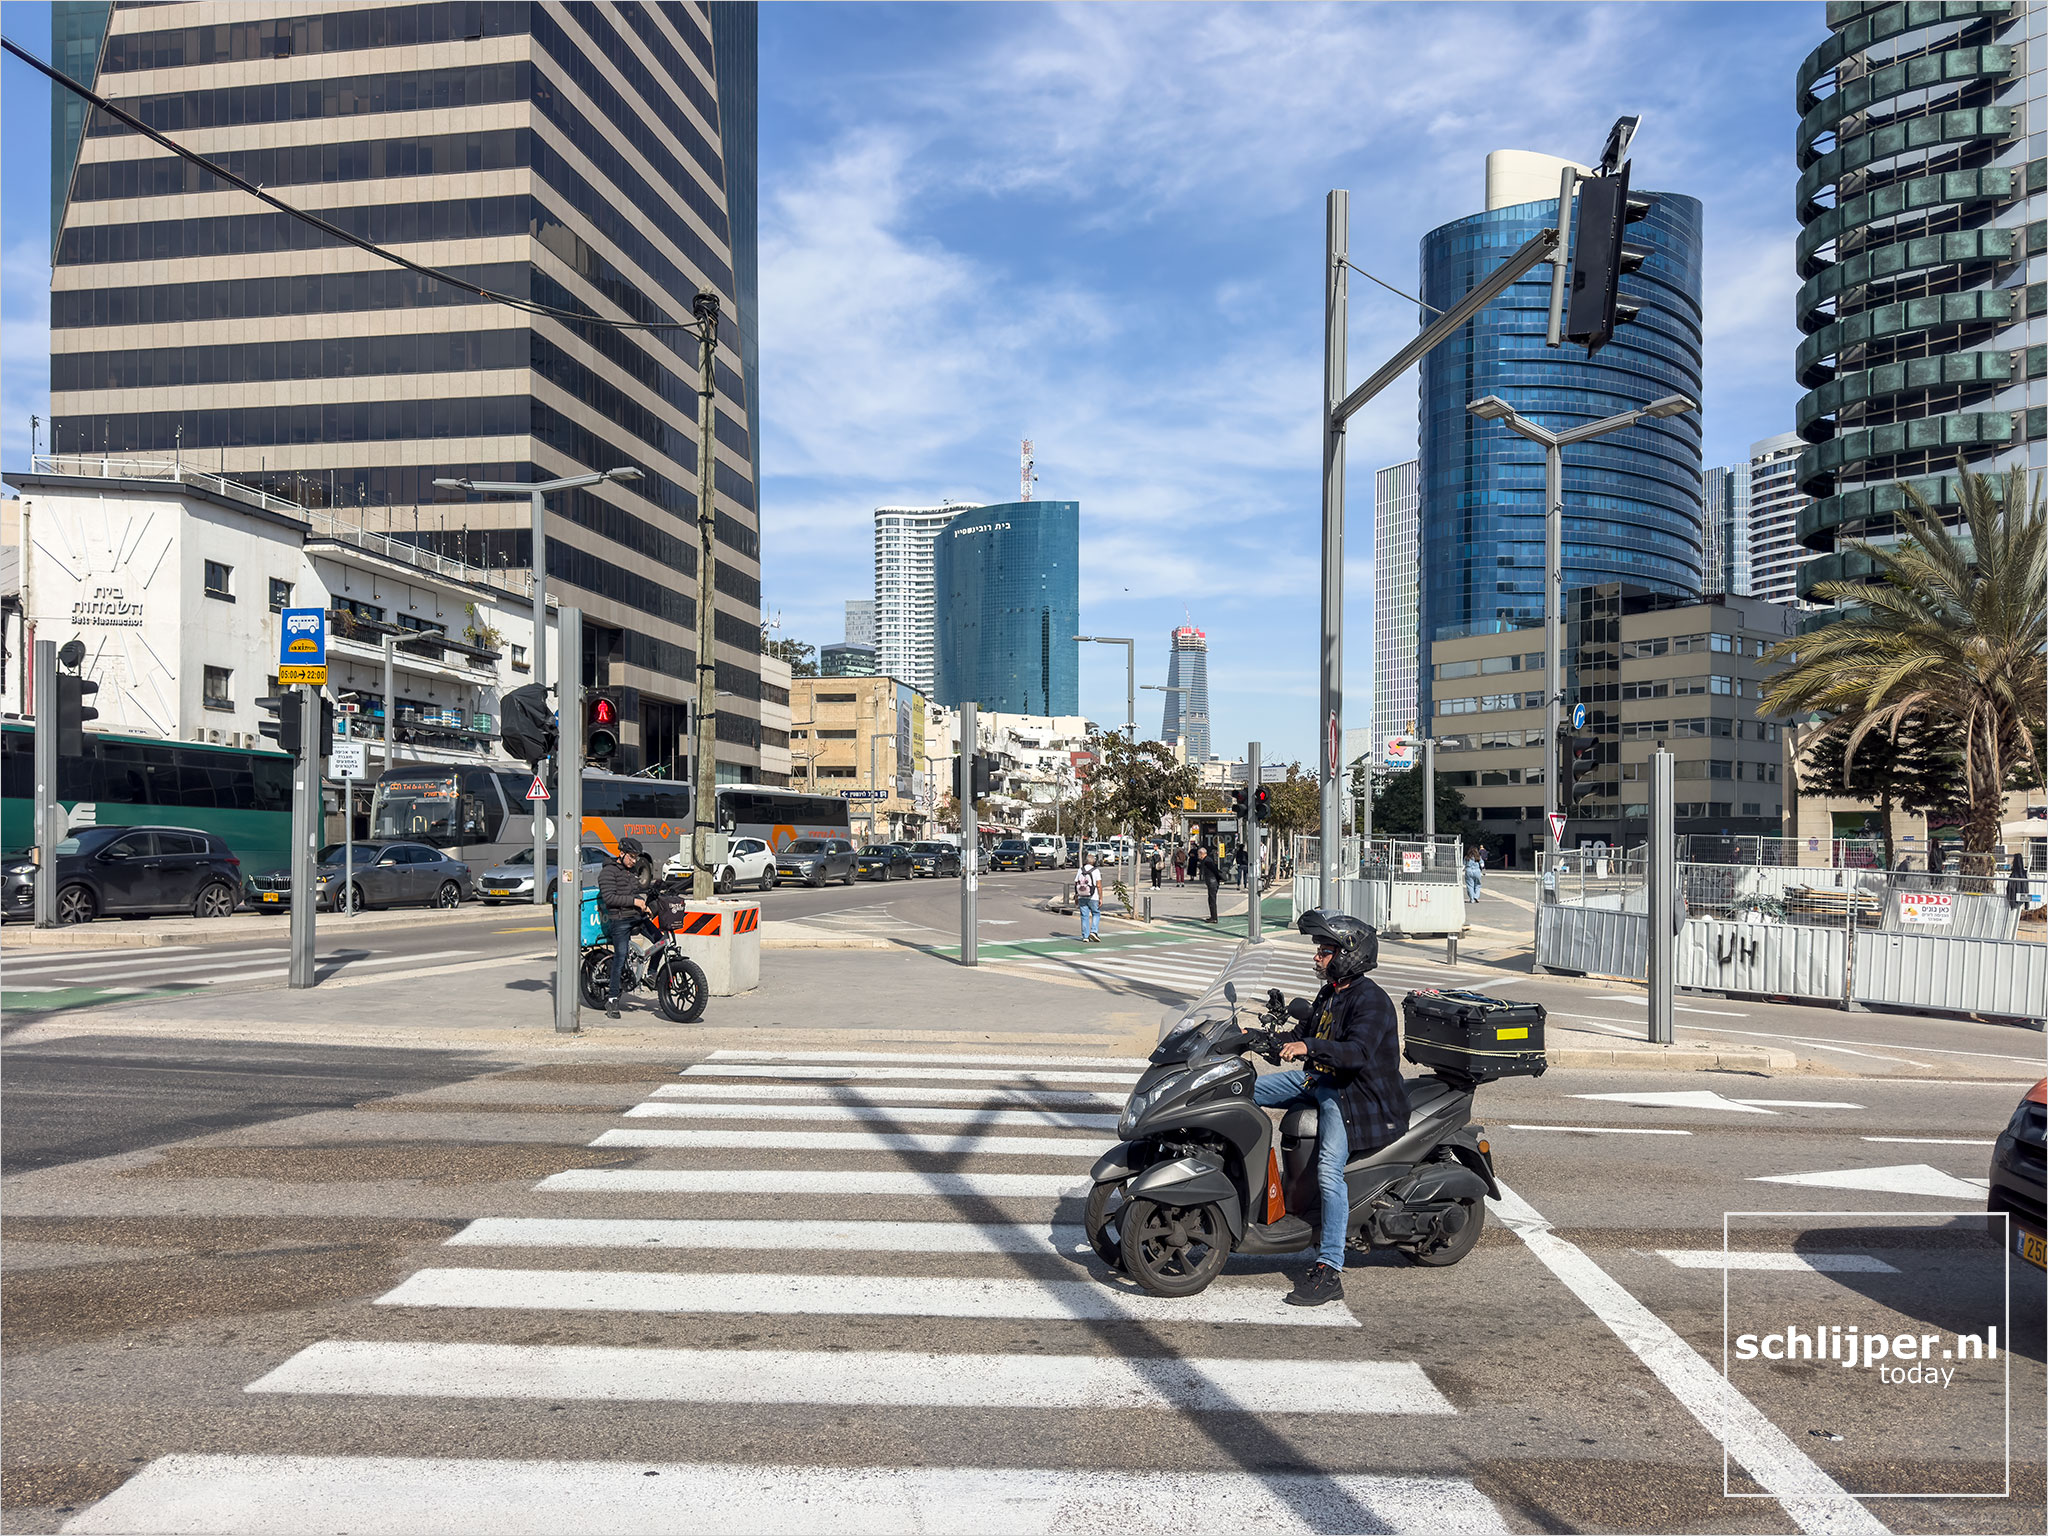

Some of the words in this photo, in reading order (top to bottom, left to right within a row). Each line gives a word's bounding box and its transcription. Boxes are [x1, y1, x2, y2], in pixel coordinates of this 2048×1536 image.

[995, 522, 1011, 530] בית
[94, 587, 124, 600] בית
[72, 601, 143, 616] השמחות
[71, 616, 90, 626] Beit
[281, 670, 298, 679] 05:00
[307, 670, 325, 679] 22:00
[623, 823, 658, 838] מטרופולין
[1902, 894, 1951, 906] סכנה!
[1938, 906, 1950, 914] כאן
